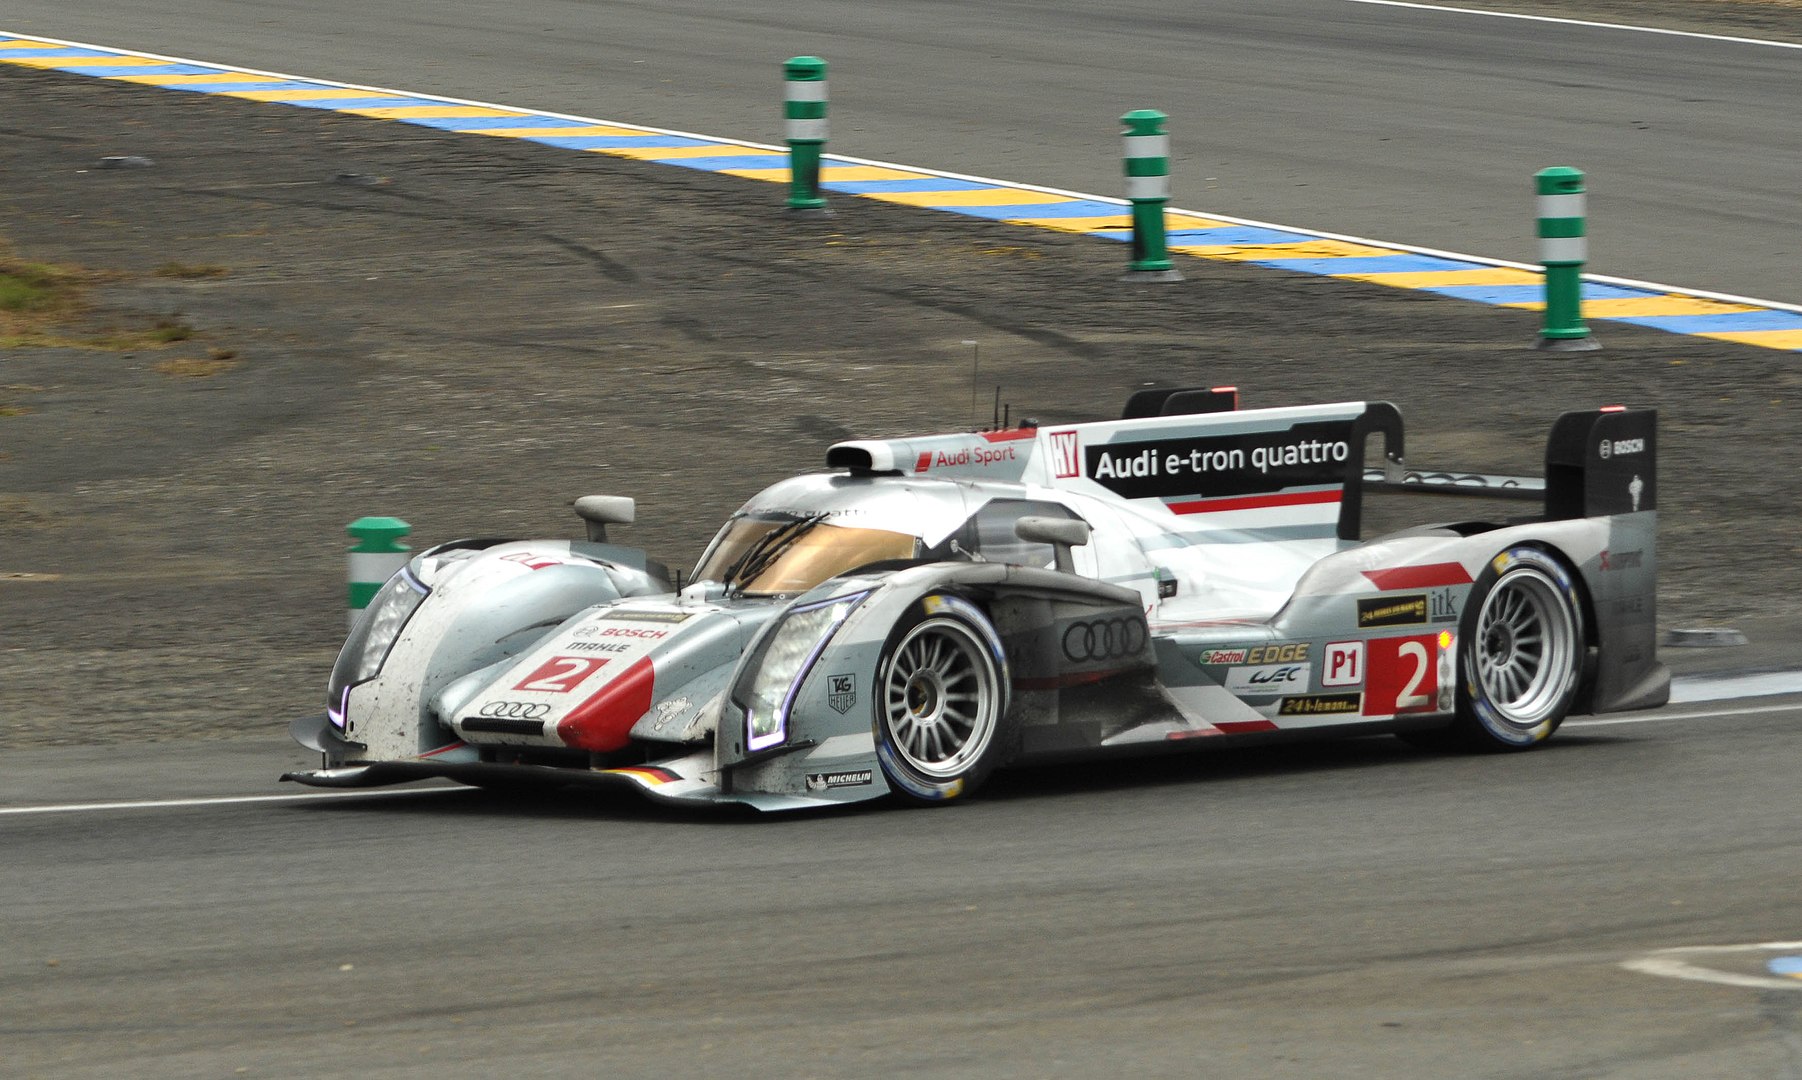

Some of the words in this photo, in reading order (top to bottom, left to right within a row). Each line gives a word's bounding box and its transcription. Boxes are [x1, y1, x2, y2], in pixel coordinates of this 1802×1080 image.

[936, 448, 969, 467] Audi
[974, 446, 1016, 466] Sport
[1051, 433, 1078, 477] HY
[1613, 438, 1645, 455] BOSCH
[1095, 449, 1158, 479] Audi
[1165, 448, 1244, 475] e-tron
[1251, 439, 1349, 474] quattro
[1431, 587, 1457, 615] itk
[599, 628, 669, 639] BOSCH
[565, 641, 631, 653] MAHLE
[1210, 650, 1245, 663] Castrol
[1247, 643, 1312, 665] EDGE
[523, 658, 590, 690] 2
[1330, 649, 1358, 679] P1
[1395, 641, 1429, 708] 2
[832, 677, 852, 693] TAG
[1249, 666, 1302, 684] WEC
[829, 695, 856, 712] HEUER
[827, 772, 872, 784] MICHELIN
